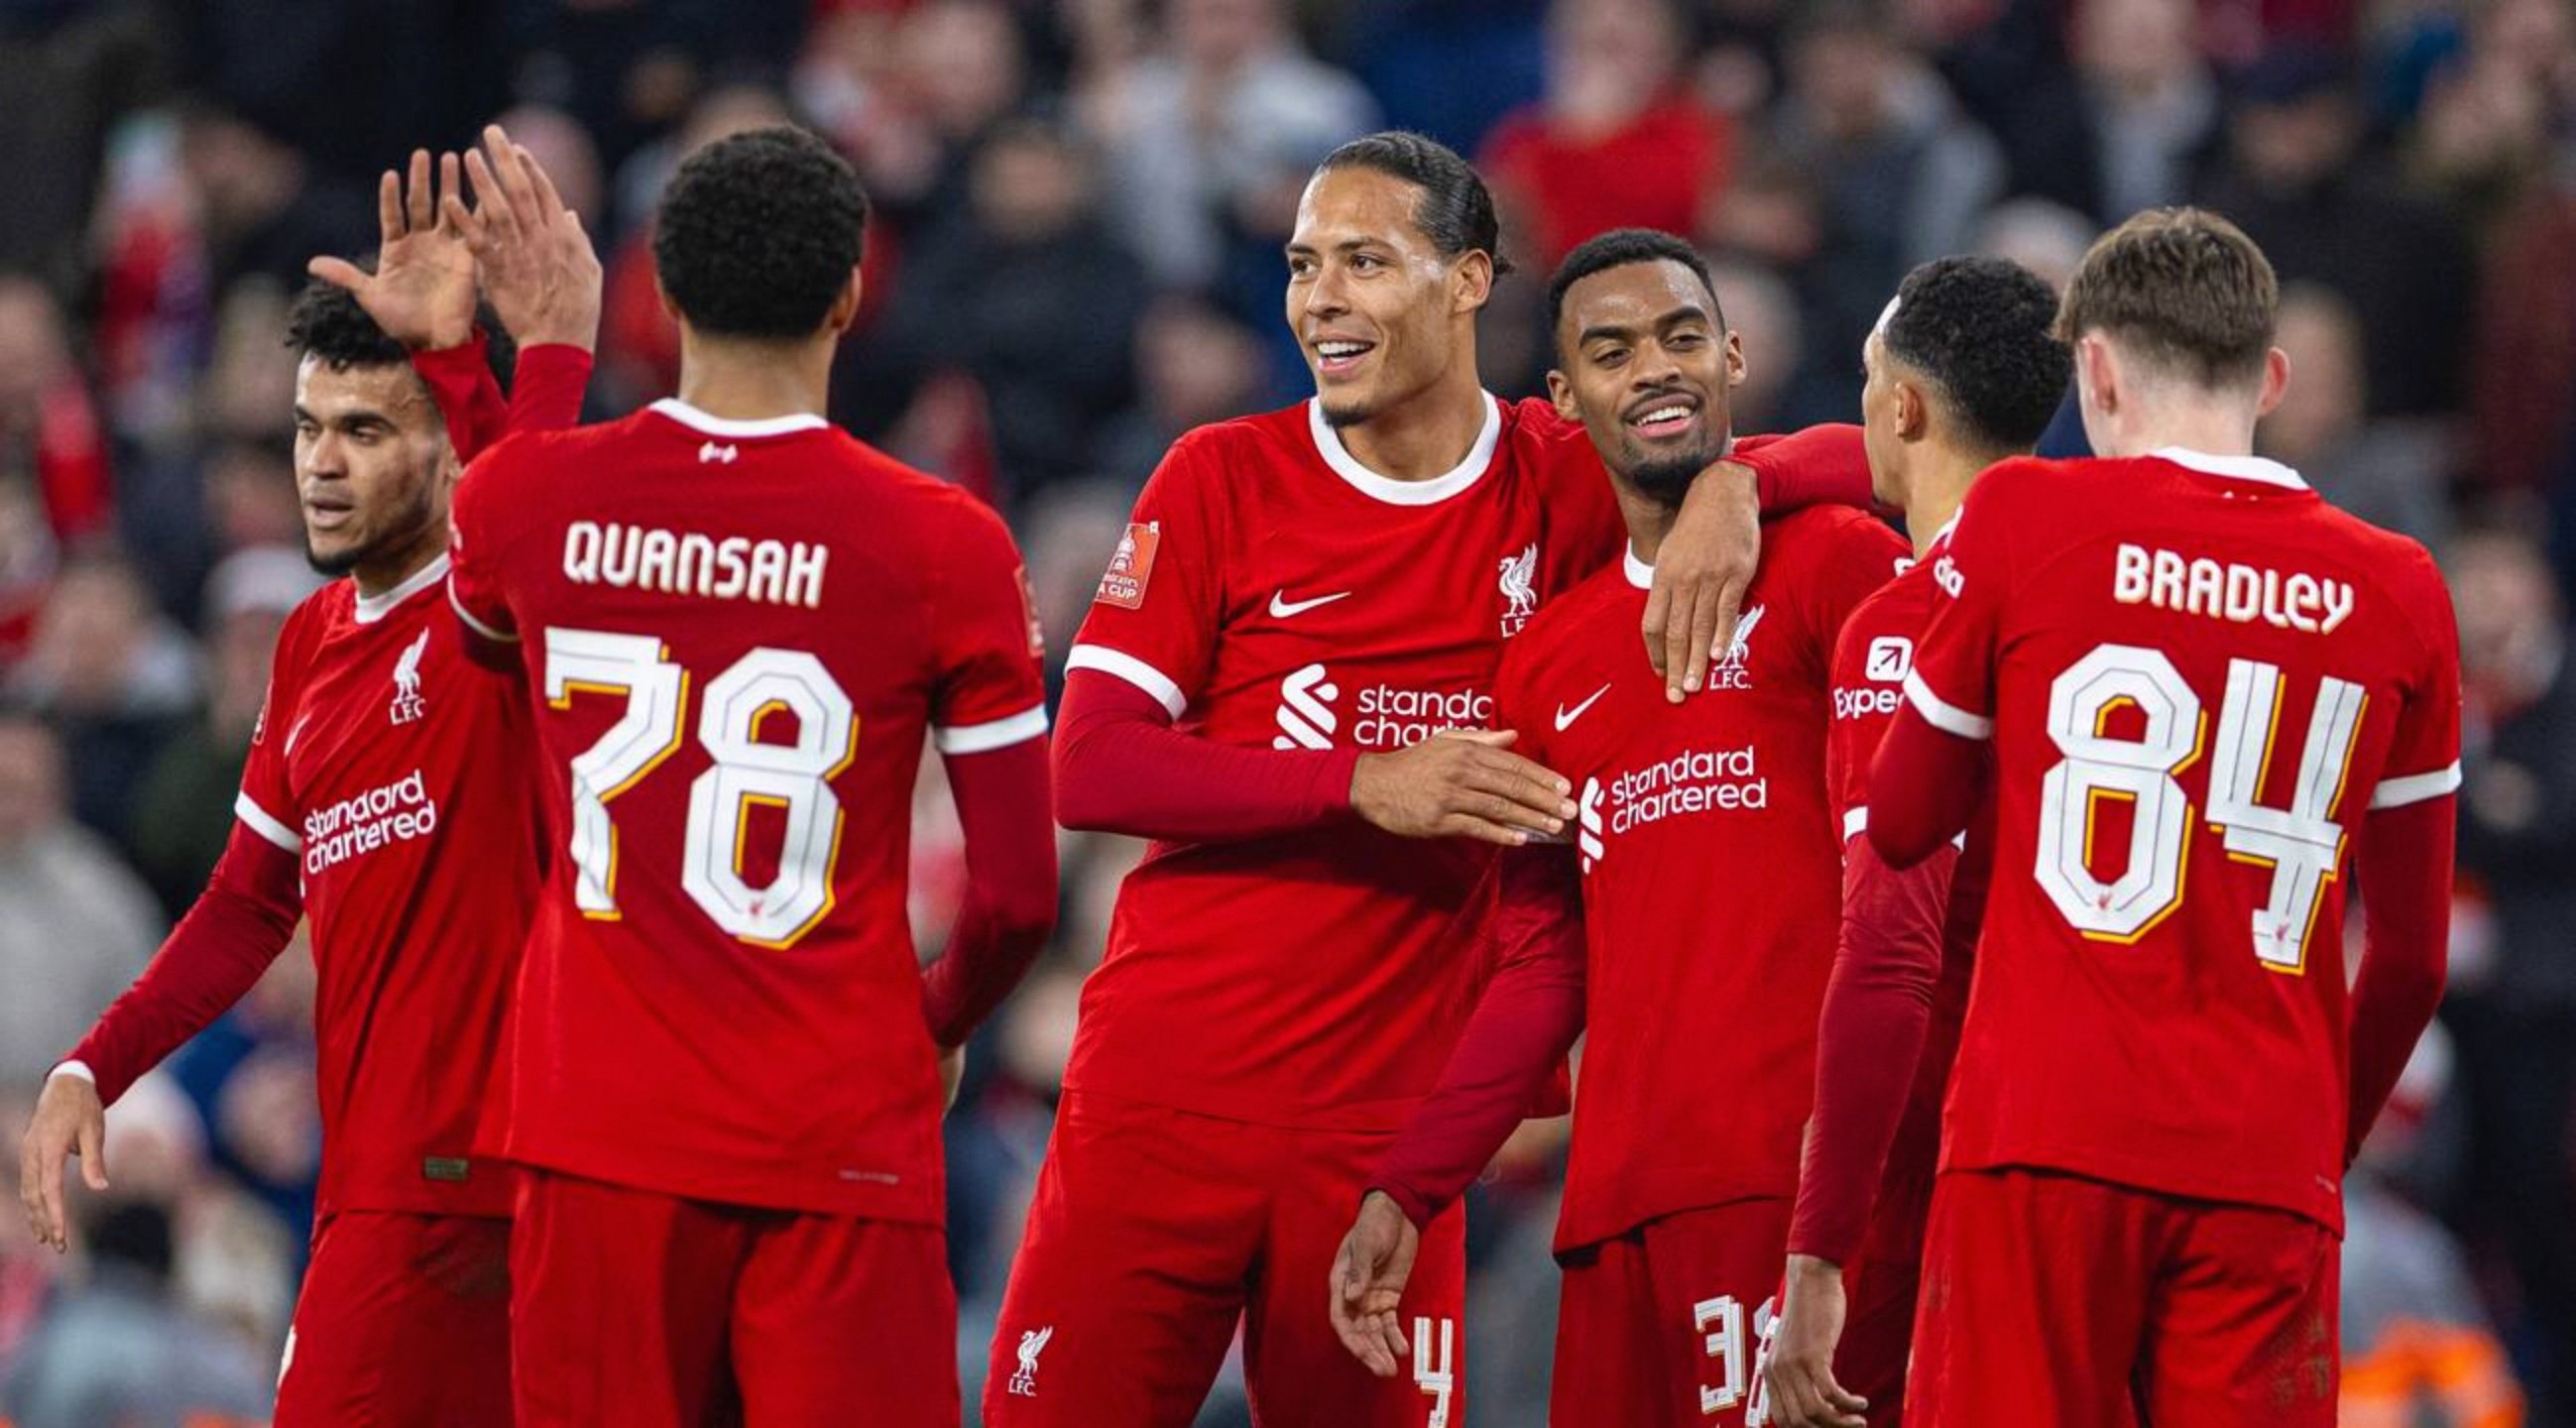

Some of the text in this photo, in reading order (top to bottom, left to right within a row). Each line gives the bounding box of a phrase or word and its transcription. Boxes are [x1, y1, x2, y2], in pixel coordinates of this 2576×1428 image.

[563, 520, 829, 608] QUANSAH
[1109, 584, 1138, 599] CUP
[2114, 542, 2354, 634] BRADLEY
[1356, 683, 1493, 720] standa
[1833, 687, 1903, 720] Expe
[304, 768, 424, 843] standard
[544, 626, 860, 950] 78
[1611, 745, 1754, 805] standard
[1611, 777, 1767, 833] chartered
[2034, 643, 2370, 976] 84
[306, 798, 435, 875] chartered
[1414, 1317, 1454, 1428] 4
[1694, 1294, 1773, 1420] 3
